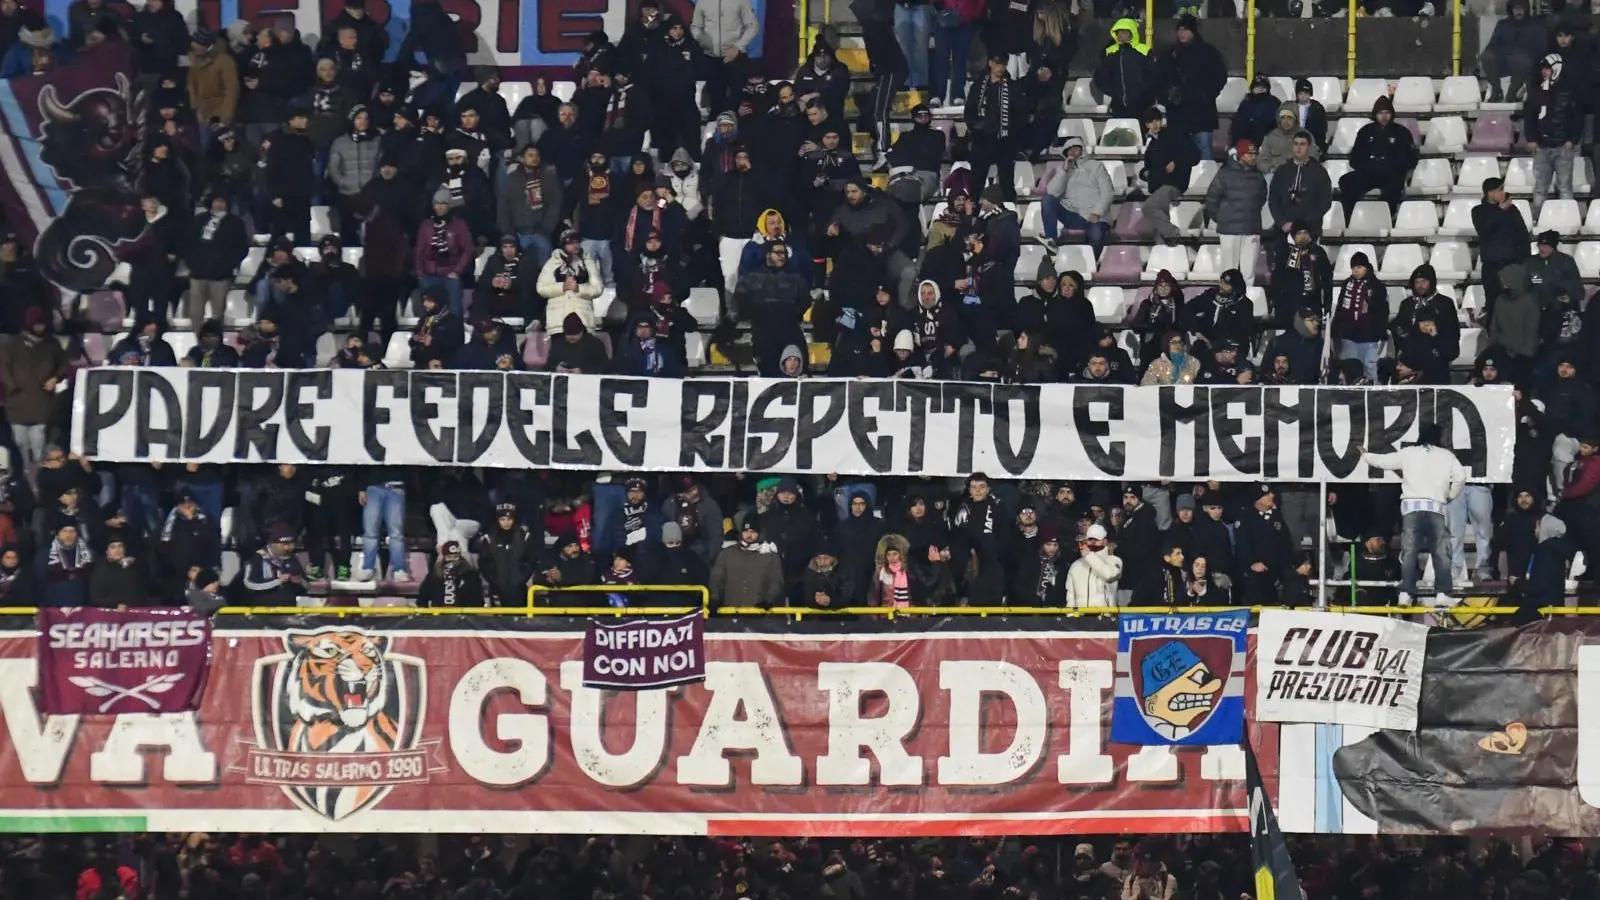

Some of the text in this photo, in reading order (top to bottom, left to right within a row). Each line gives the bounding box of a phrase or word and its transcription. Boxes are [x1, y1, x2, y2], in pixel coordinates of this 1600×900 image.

[84, 370, 332, 460] PADRE
[363, 371, 649, 466] FEDELE
[679, 381, 1041, 475] RISPETTO
[1073, 386, 1125, 477] E
[49, 620, 206, 651] SEAHORSES
[595, 621, 693, 649] DIFFIDATI
[1123, 615, 1212, 634] ULTRAS
[74, 651, 179, 669] SALERNO
[594, 649, 695, 675] CON NOI
[1275, 628, 1411, 674] CLUB DAL
[1267, 670, 1409, 707] PRESIDENTE
[254, 756, 422, 780] ULTRAS SALERNO 1990
